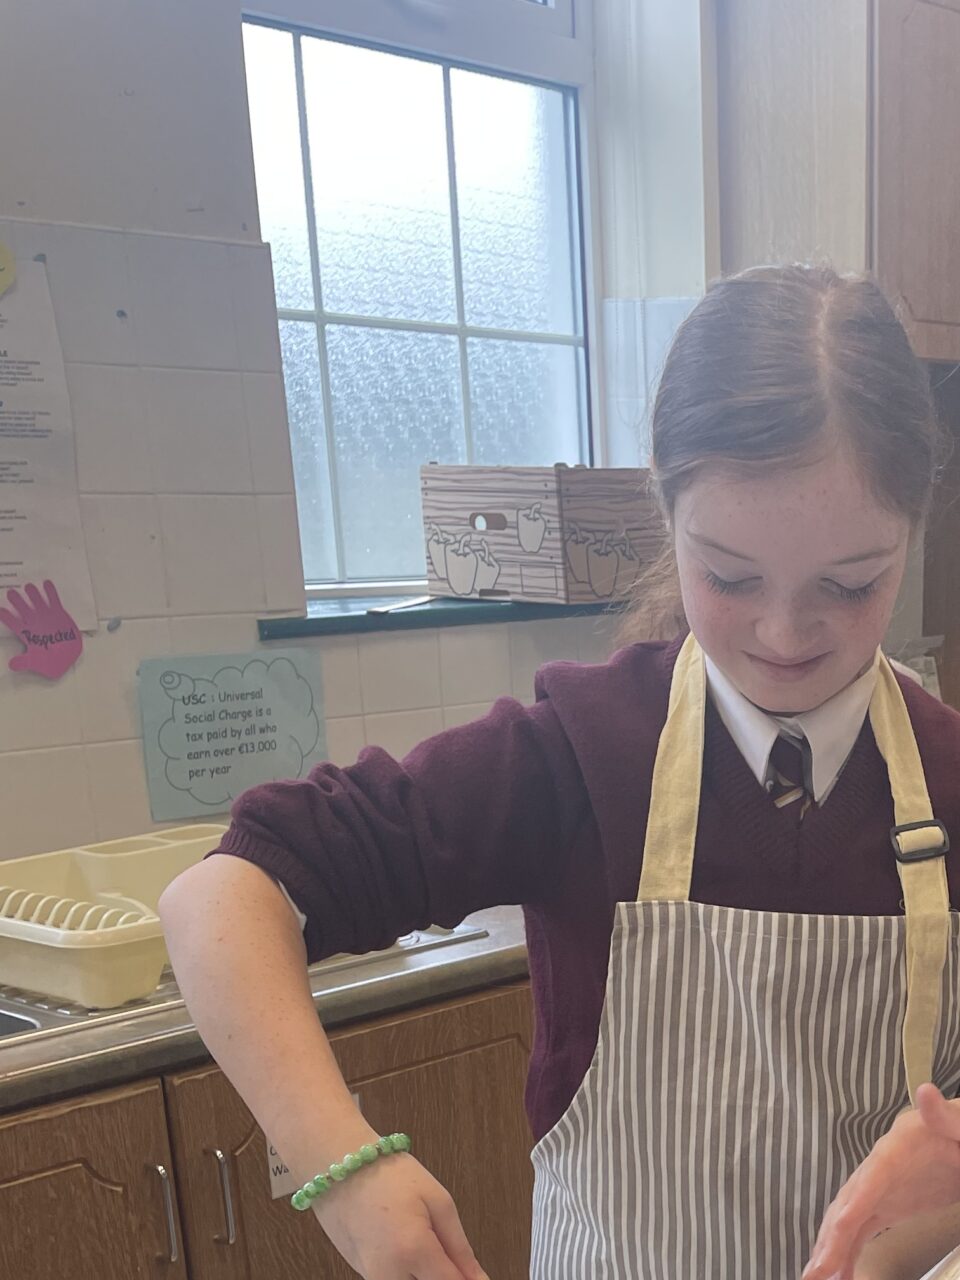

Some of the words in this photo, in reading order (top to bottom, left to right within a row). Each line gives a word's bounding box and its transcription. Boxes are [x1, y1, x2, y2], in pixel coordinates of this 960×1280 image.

[22, 629, 77, 650] Respected
[182, 693, 206, 706] USC
[218, 687, 263, 702] Universal
[184, 710, 215, 724] Social
[218, 708, 252, 721] Charge
[256, 706, 263, 717] is
[266, 707, 272, 715] a
[186, 732, 203, 742] tax
[207, 728, 227, 742] paid
[230, 726, 242, 740] by
[244, 723, 256, 736] all
[258, 723, 277, 734] who
[187, 749, 211, 760] earn
[213, 747, 235, 758] over
[238, 739, 277, 754] €13,000
[188, 767, 206, 781] per
[209, 764, 232, 779] year
